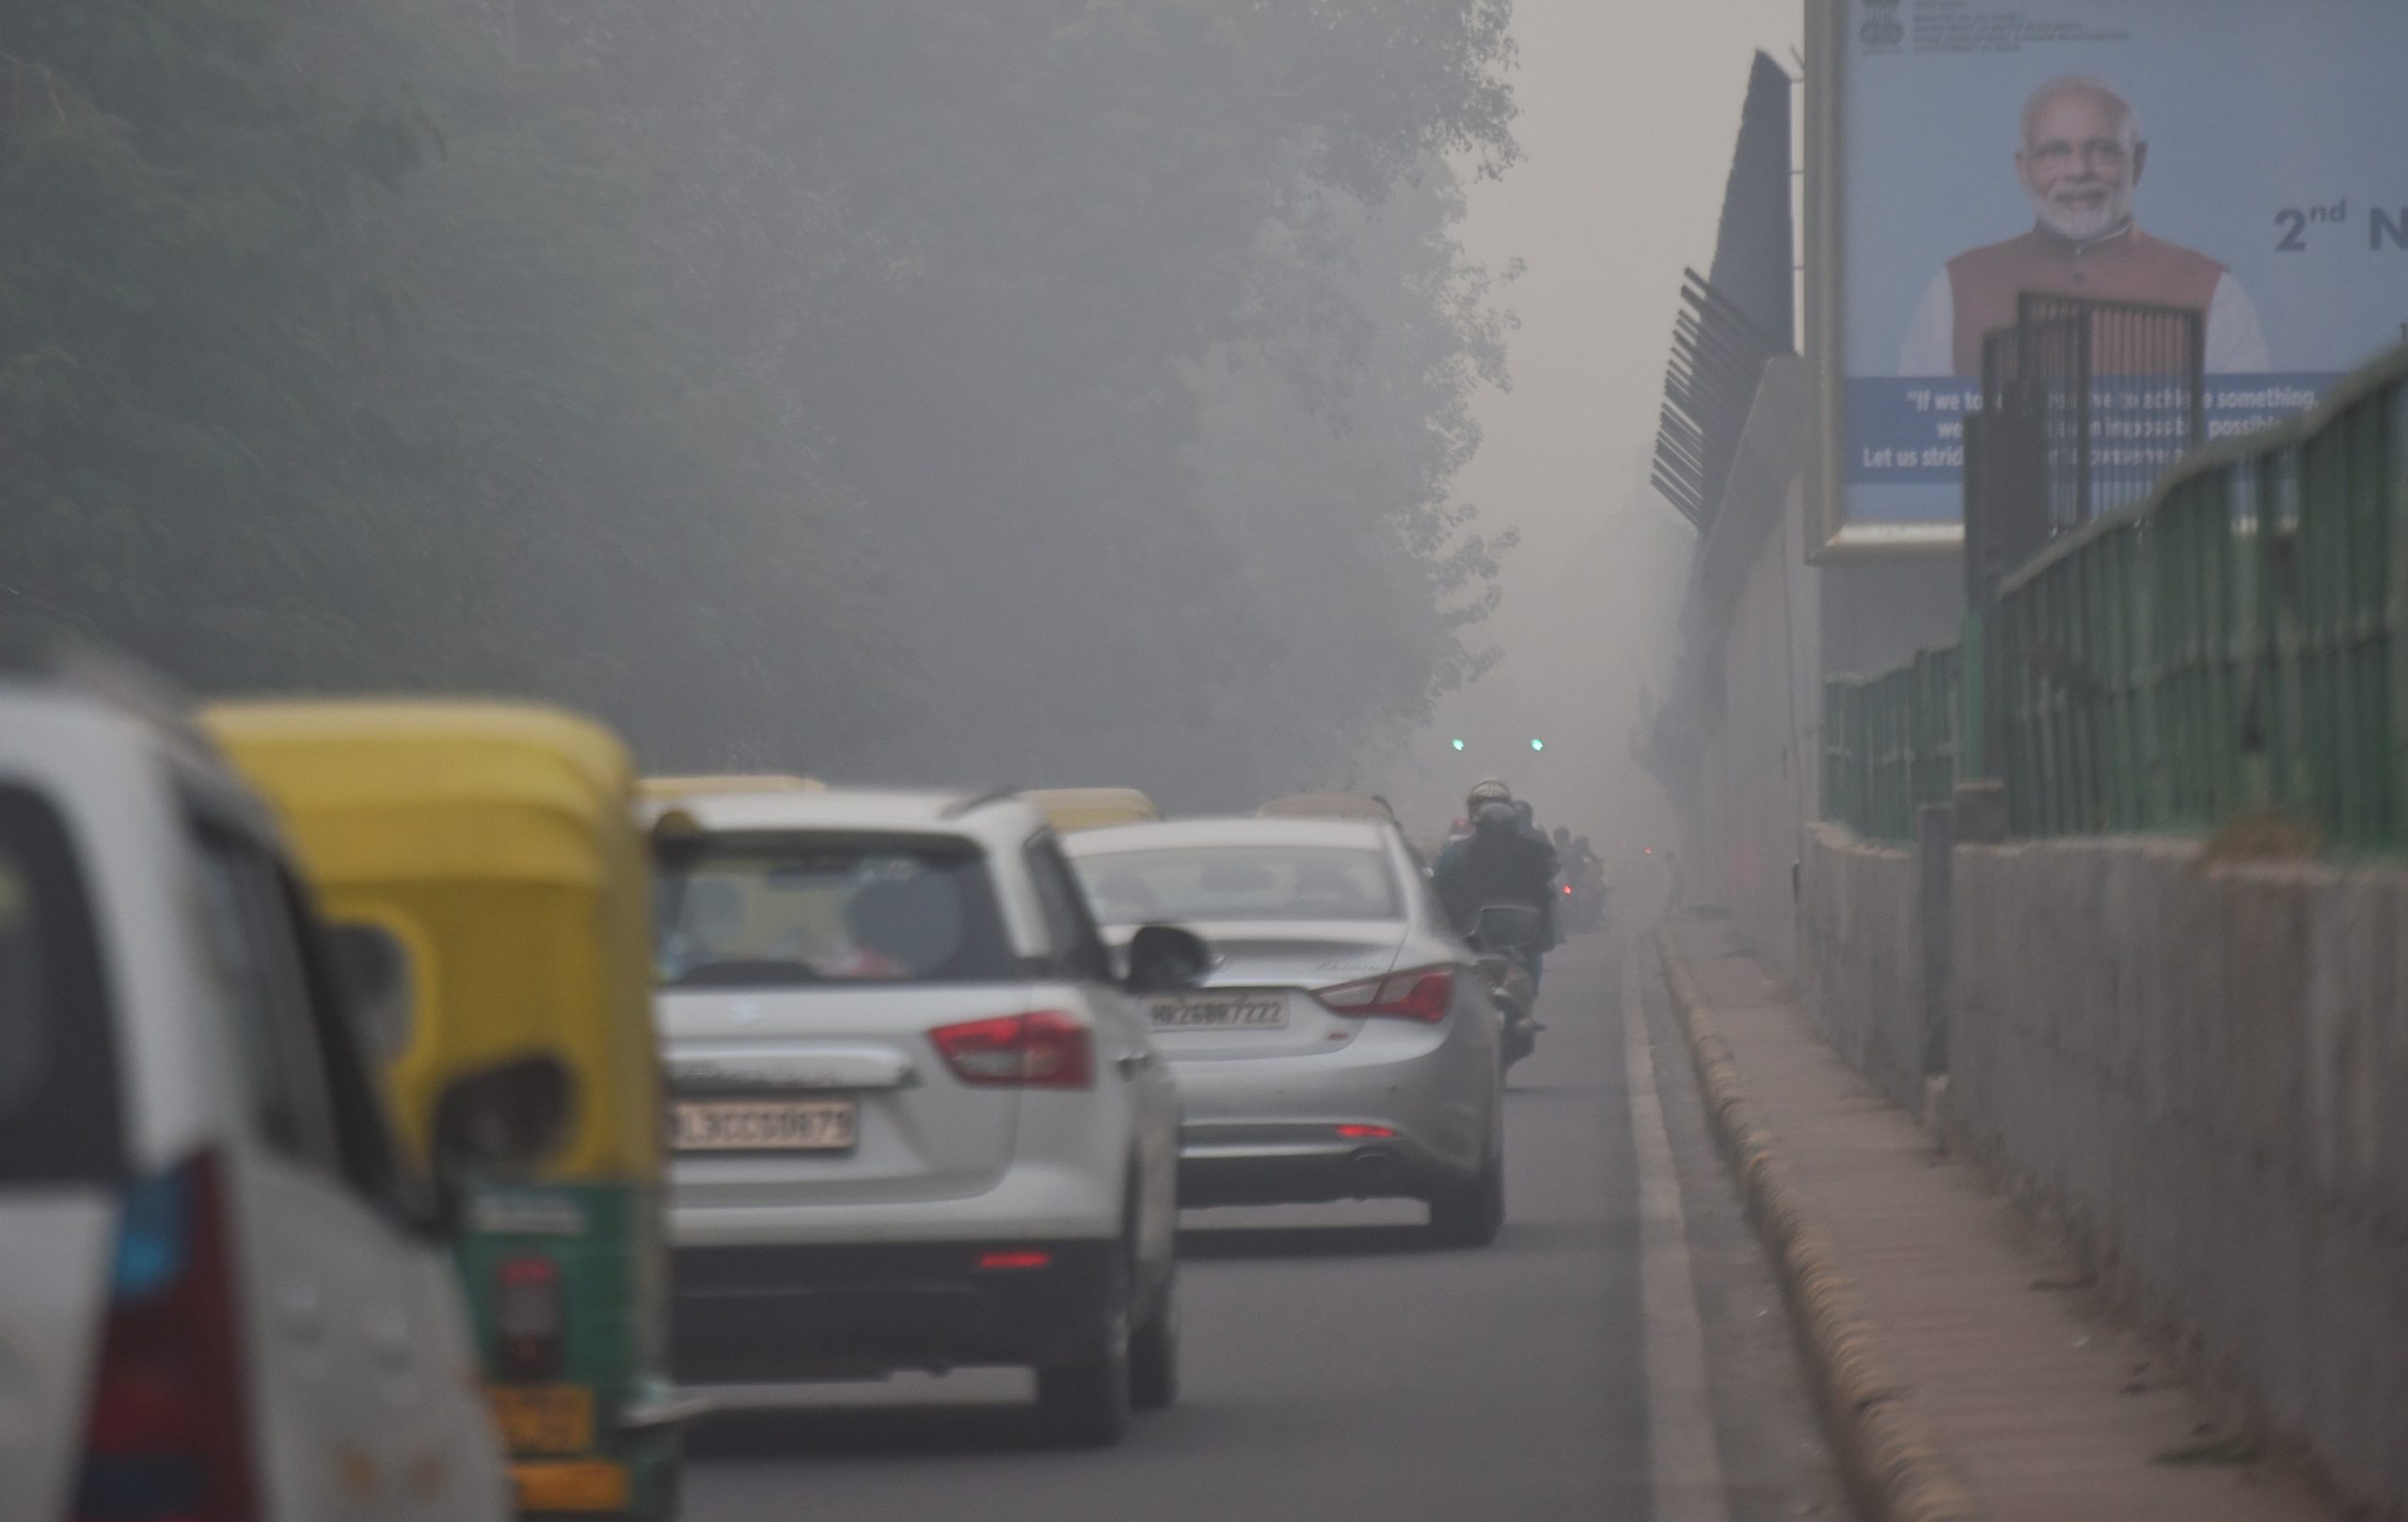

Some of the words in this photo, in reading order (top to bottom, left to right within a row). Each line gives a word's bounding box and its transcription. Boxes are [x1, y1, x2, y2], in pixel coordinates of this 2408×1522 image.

[2274, 197, 2346, 252] 2nd
[1935, 393, 1960, 410] we
[2216, 387, 2320, 411] something,
[1863, 447, 1893, 468] Let
[1895, 451, 1918, 468] us
[1922, 445, 1964, 468] strid
